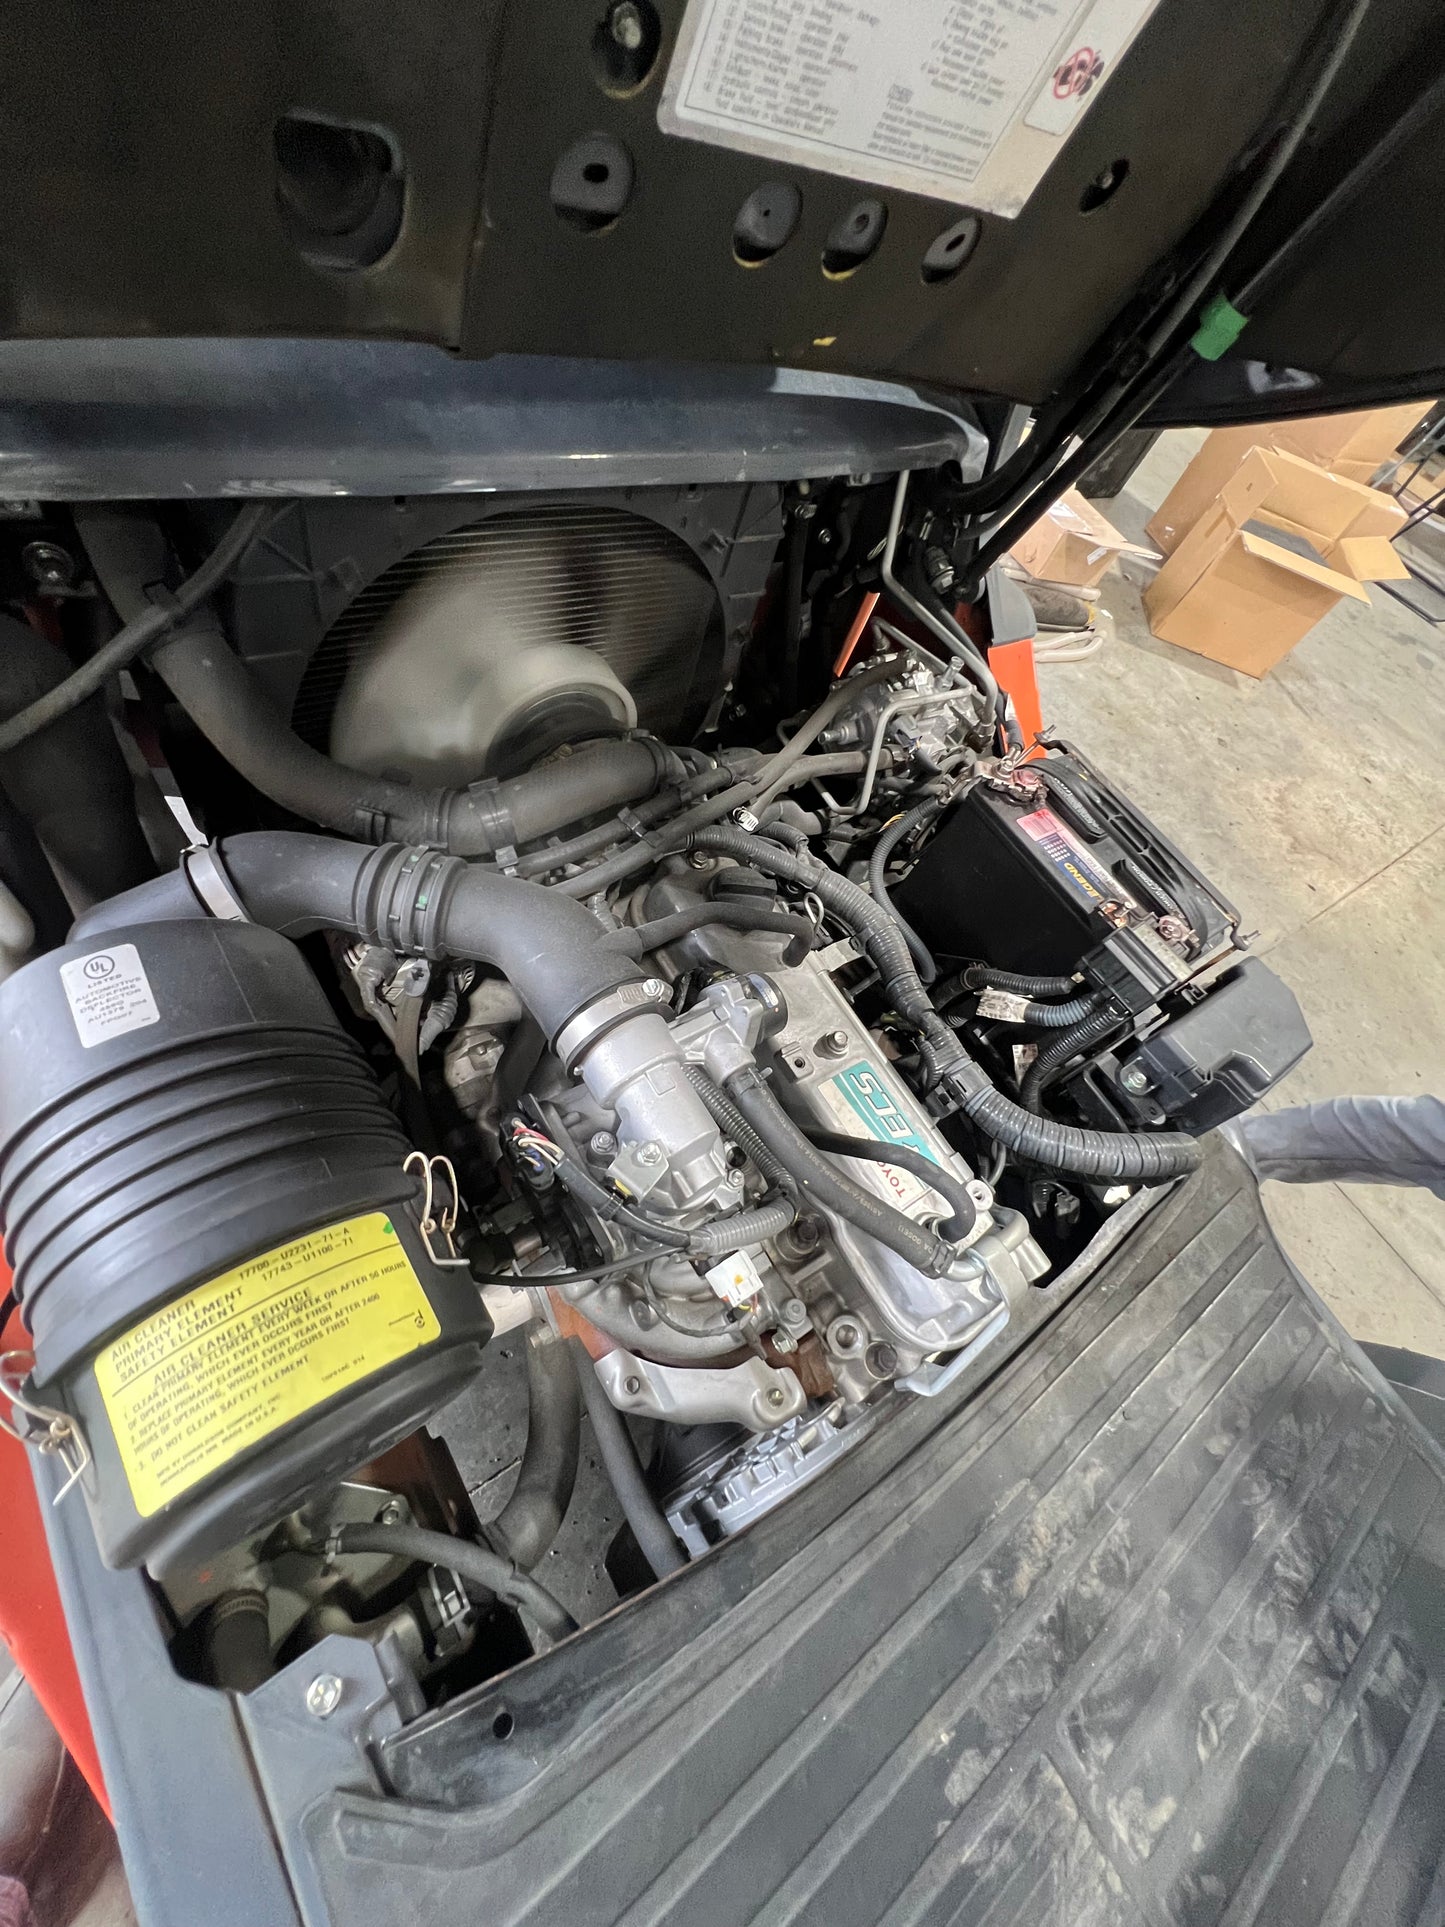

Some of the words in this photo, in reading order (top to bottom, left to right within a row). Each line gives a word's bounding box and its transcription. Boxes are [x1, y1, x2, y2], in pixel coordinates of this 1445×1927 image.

[90, 961, 109, 973] UL
[849, 1071, 914, 1139] ECS
[112, 1340, 131, 1362] AIR
[134, 1300, 196, 1346] CLEANER
[115, 1326, 173, 1373] PRIMARY
[177, 1286, 243, 1330] ELEMENT
[119, 1345, 166, 1381] SAFETY
[171, 1303, 236, 1348] ELEMENT
[128, 1418, 139, 1431] OF
[194, 1357, 231, 1384] WHICH
[233, 1340, 260, 1361] EVER
[262, 1316, 304, 1341] OCCURS
[305, 1301, 333, 1322] FIRST
[132, 1387, 159, 1414] CLEAN
[162, 1356, 204, 1393] PRIMARY
[207, 1330, 255, 1363] ELEMENT
[257, 1305, 291, 1333] EVERY
[293, 1294, 322, 1315] WEEK
[324, 1288, 338, 1301] OR
[341, 1274, 368, 1293] AFTER
[381, 1260, 407, 1276] HOURS
[139, 1409, 172, 1437] REPLACE
[174, 1382, 213, 1412] PRIMARY
[216, 1352, 259, 1384] ELEMENT
[261, 1336, 291, 1358] EVERY
[294, 1323, 318, 1340] YEAR
[320, 1315, 333, 1327] OR
[335, 1302, 361, 1320] AFTER
[154, 1360, 177, 1385] AIR
[180, 1322, 247, 1366] CLEANER
[252, 1286, 312, 1325] SERVICE
[133, 1433, 159, 1456] HOURS
[160, 1424, 171, 1436] OF
[226, 1366, 260, 1391] WHICH
[261, 1352, 286, 1370] EVER
[287, 1331, 324, 1354] OCCURS
[326, 1317, 350, 1335] FIRST
[151, 1448, 164, 1462] DO
[164, 1434, 183, 1451] NOT
[186, 1408, 218, 1437] CLEAN
[219, 1385, 259, 1414] SAFETY
[262, 1354, 310, 1388] ELEMENT
